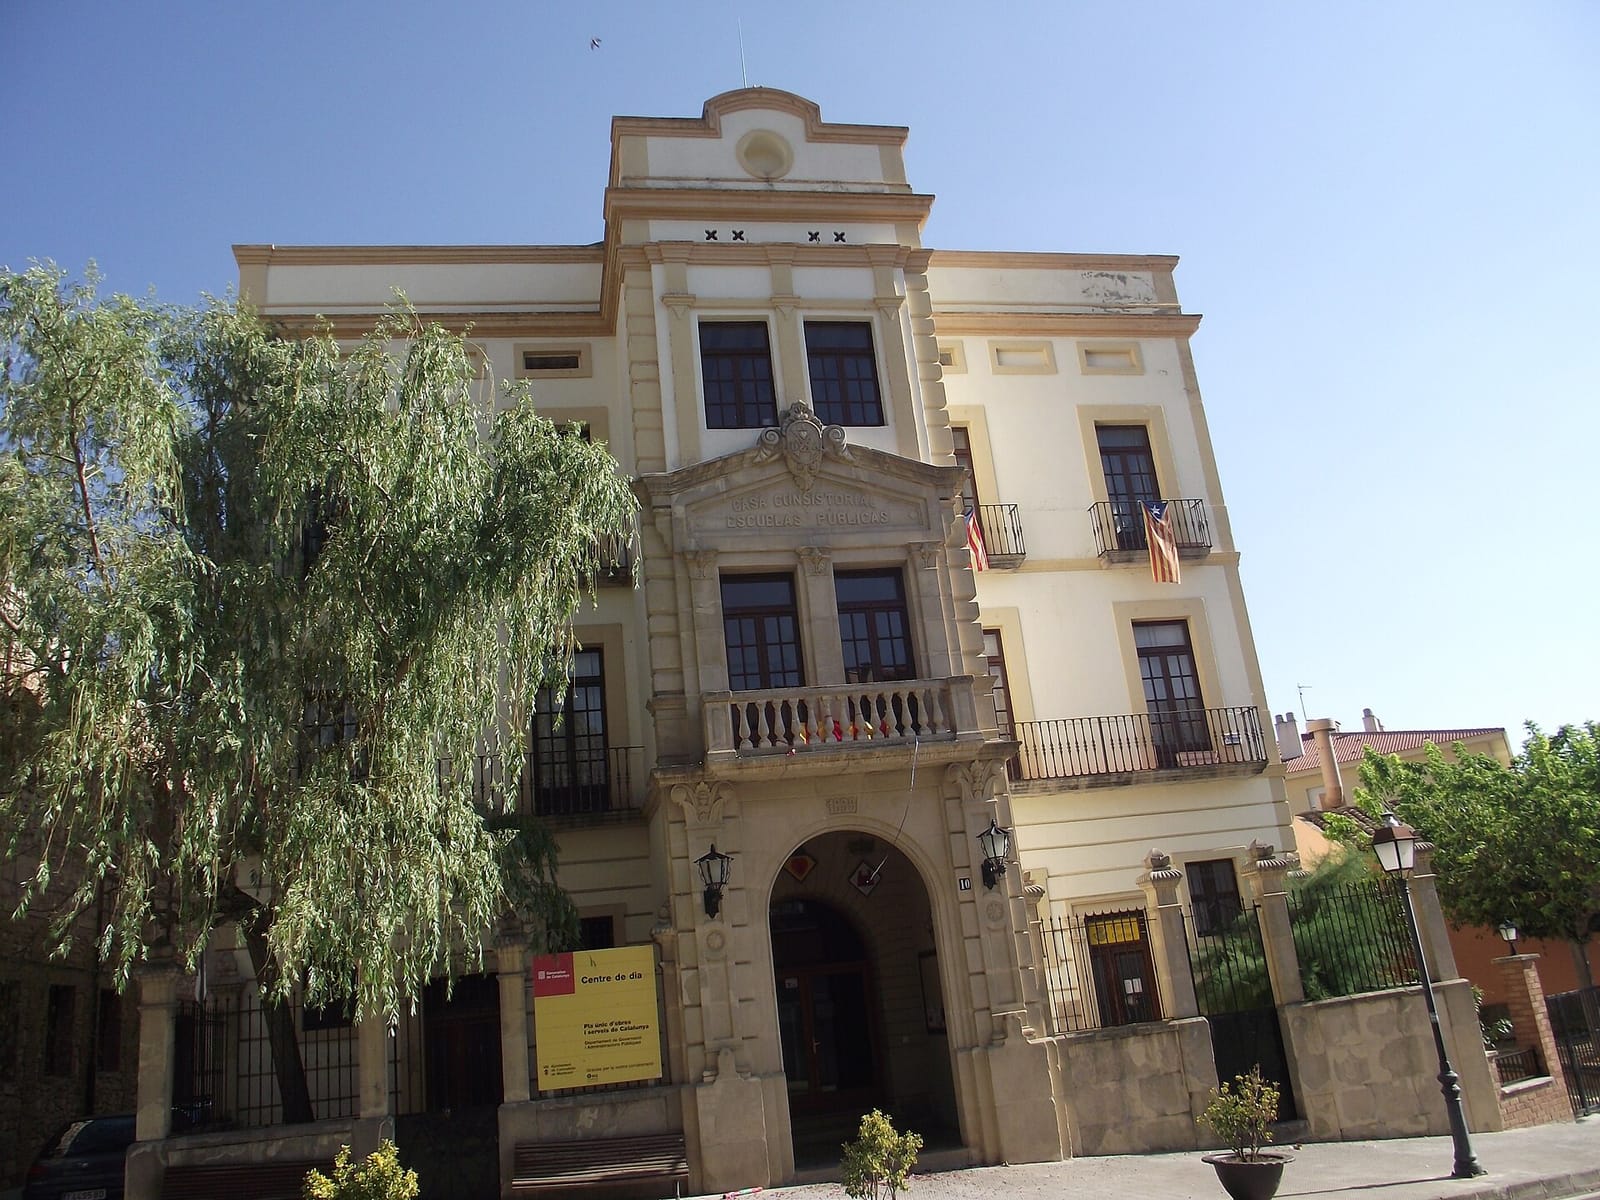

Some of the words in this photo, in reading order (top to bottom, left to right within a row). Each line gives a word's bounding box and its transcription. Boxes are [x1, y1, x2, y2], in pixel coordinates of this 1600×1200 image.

[732, 497, 768, 512] CASA
[727, 513, 801, 528] ESCUELAS
[816, 511, 889, 526] PUBLICAS
[960, 879, 970, 889] 10
[581, 975, 612, 984] Centre
[615, 972, 626, 981] de
[629, 971, 642, 979] dia
[619, 1024, 649, 1032] Catalunya
